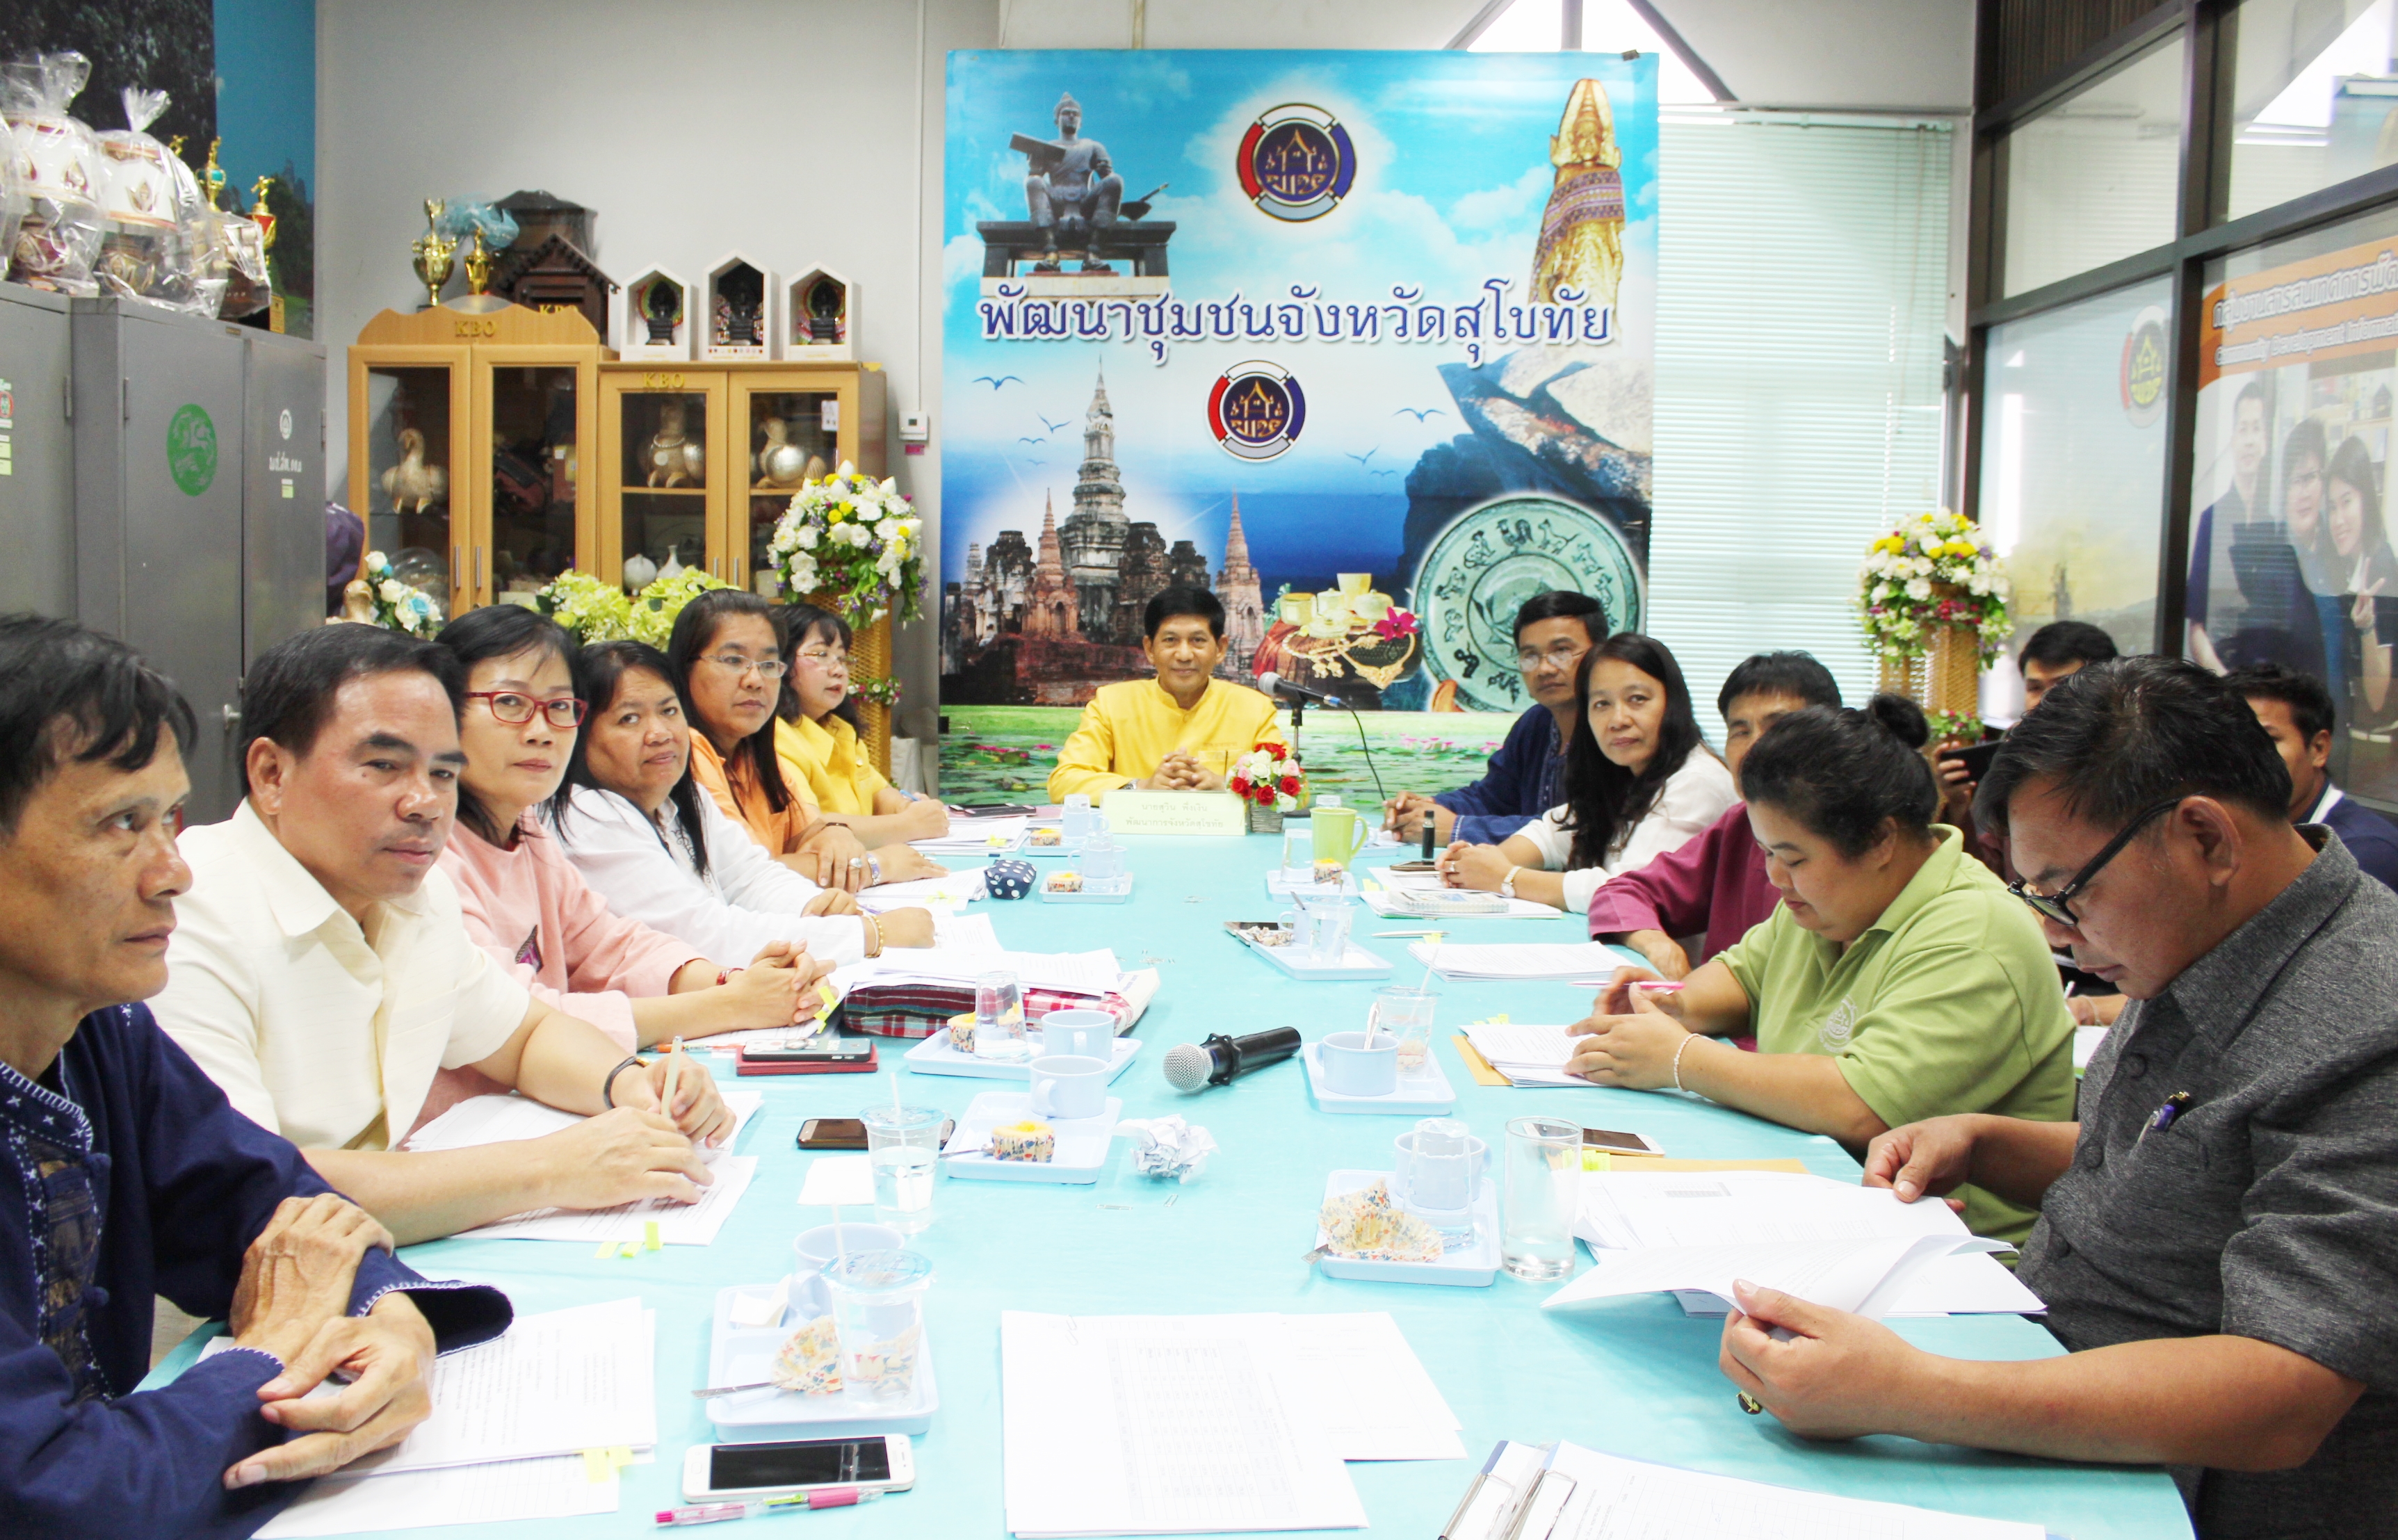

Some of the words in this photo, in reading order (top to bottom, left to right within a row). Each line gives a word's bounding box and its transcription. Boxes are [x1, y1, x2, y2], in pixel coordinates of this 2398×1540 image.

[979, 278, 1612, 364] พัฒนาชุมชนจังหวัดสุโขทัย
[455, 321, 496, 337] KBO
[644, 373, 685, 388] KBO
[1126, 816, 1224, 829] พัฒนาการจังหวัดสุโขทัย
